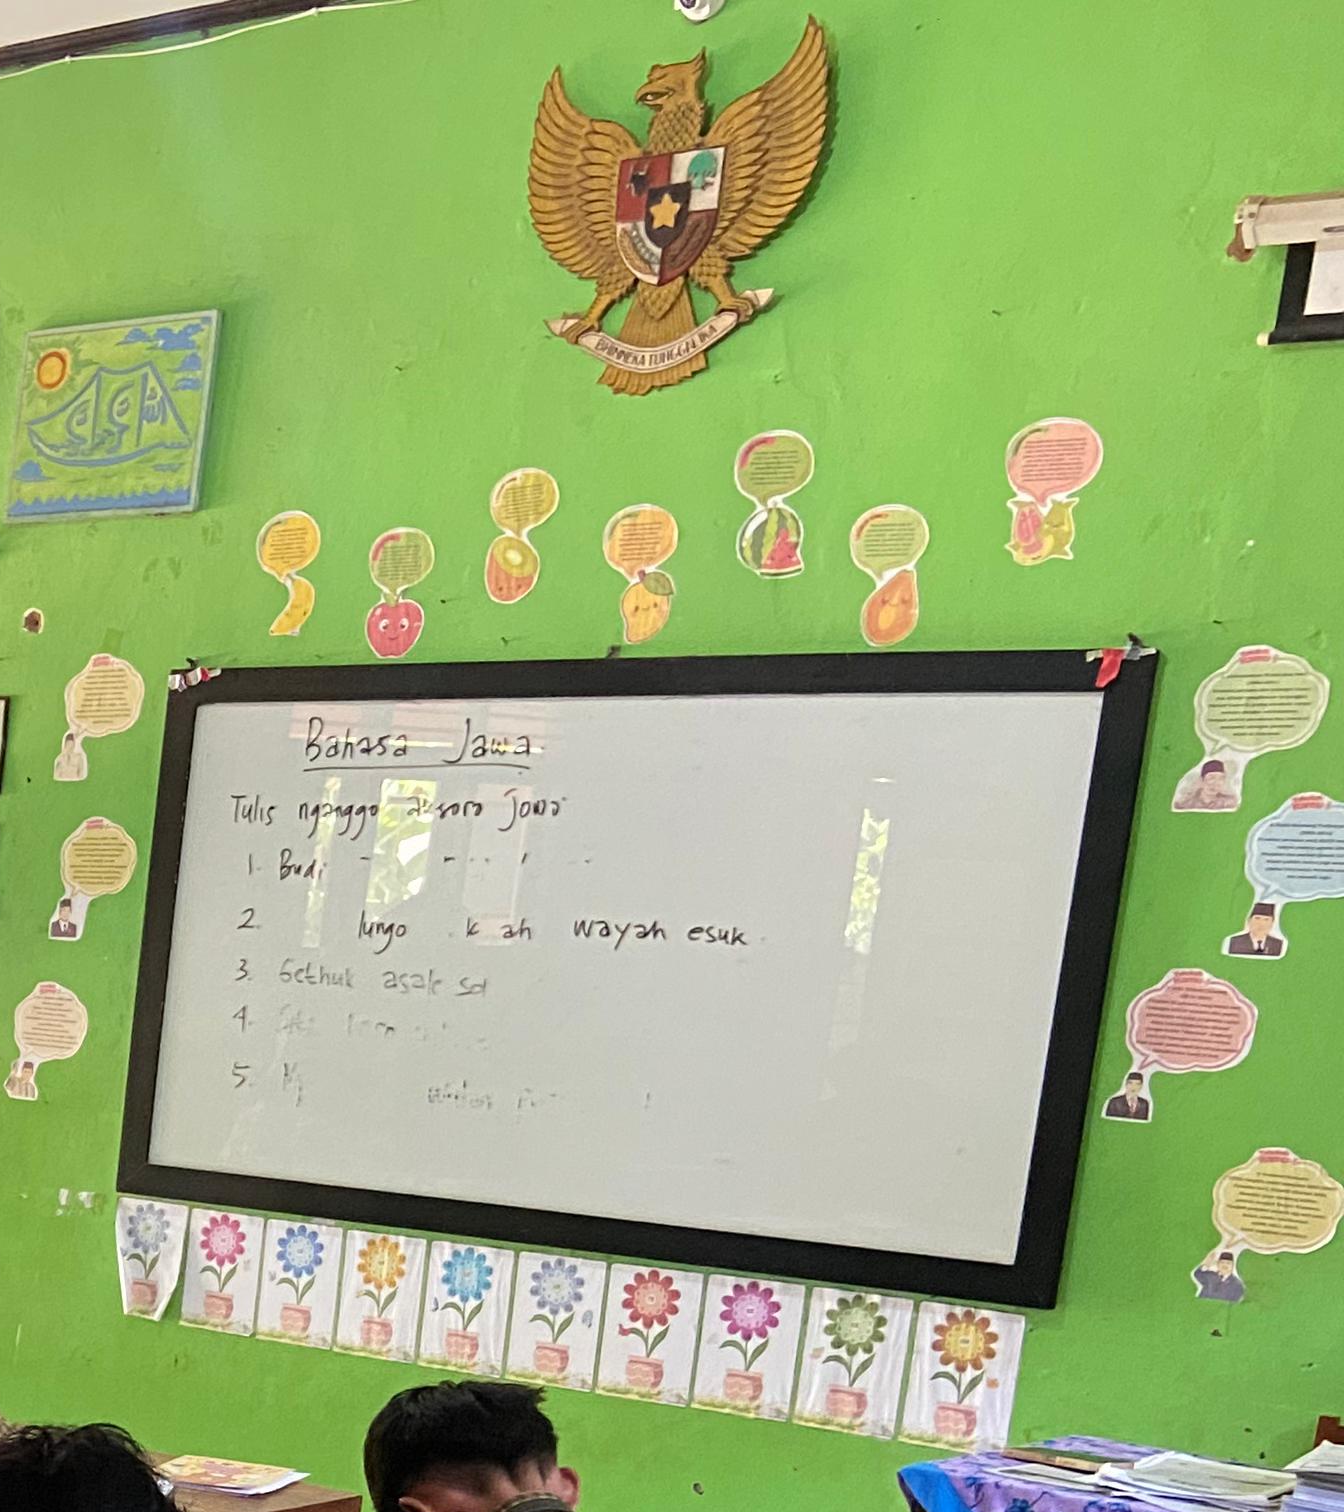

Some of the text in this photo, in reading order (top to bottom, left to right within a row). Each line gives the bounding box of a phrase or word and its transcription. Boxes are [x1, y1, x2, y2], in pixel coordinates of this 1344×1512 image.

[305, 717, 532, 764] Bahasa Jawa
[230, 794, 277, 826] Tulis
[298, 801, 379, 841] nganggo
[279, 848, 328, 880] Budi
[358, 910, 407, 955] lungo
[574, 919, 667, 950] wayah
[687, 925, 748, 946] esuk
